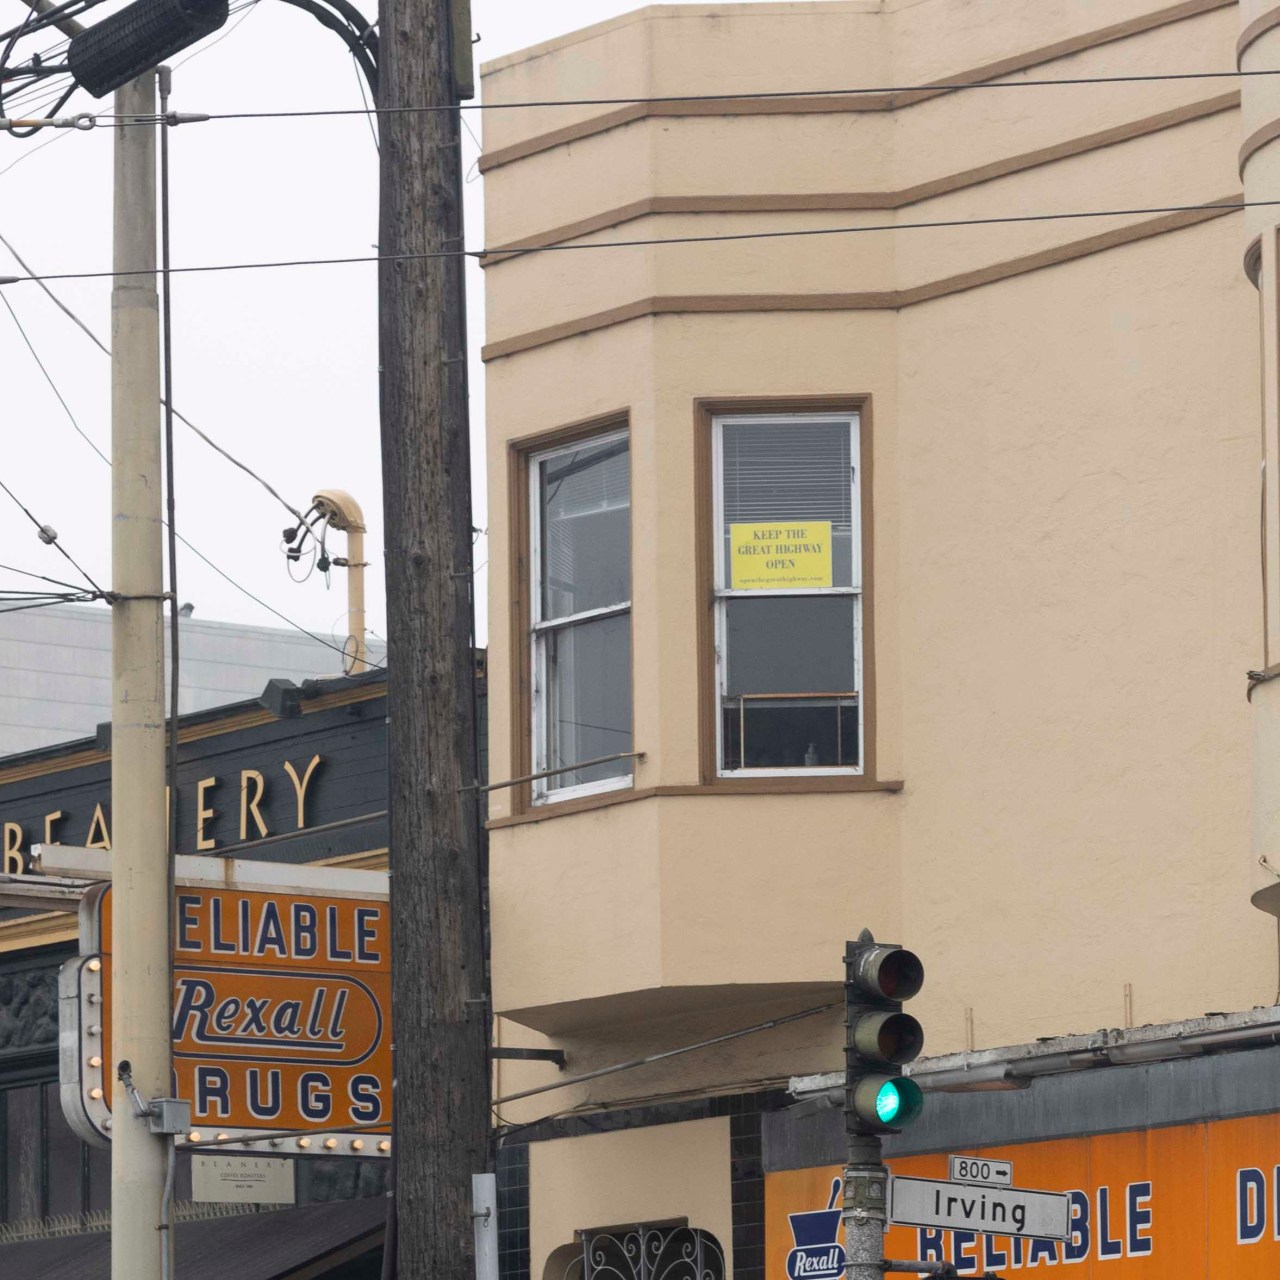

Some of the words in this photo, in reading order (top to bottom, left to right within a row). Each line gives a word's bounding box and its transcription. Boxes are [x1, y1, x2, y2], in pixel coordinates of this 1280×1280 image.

[737, 545, 773, 556] GREAT
[775, 543, 822, 554] HIGHWAY
[753, 530, 782, 540] KEEP
[786, 529, 807, 539] THE
[766, 559, 796, 569] OPEN
[4, 754, 320, 874] BEAERY
[177, 894, 382, 964] ELIABLE
[173, 977, 346, 1050] Rexall
[173, 1066, 382, 1123] RUGS
[959, 1160, 990, 1180] 800
[935, 1189, 1026, 1233] Irving
[791, 1247, 841, 1280] Rexall
